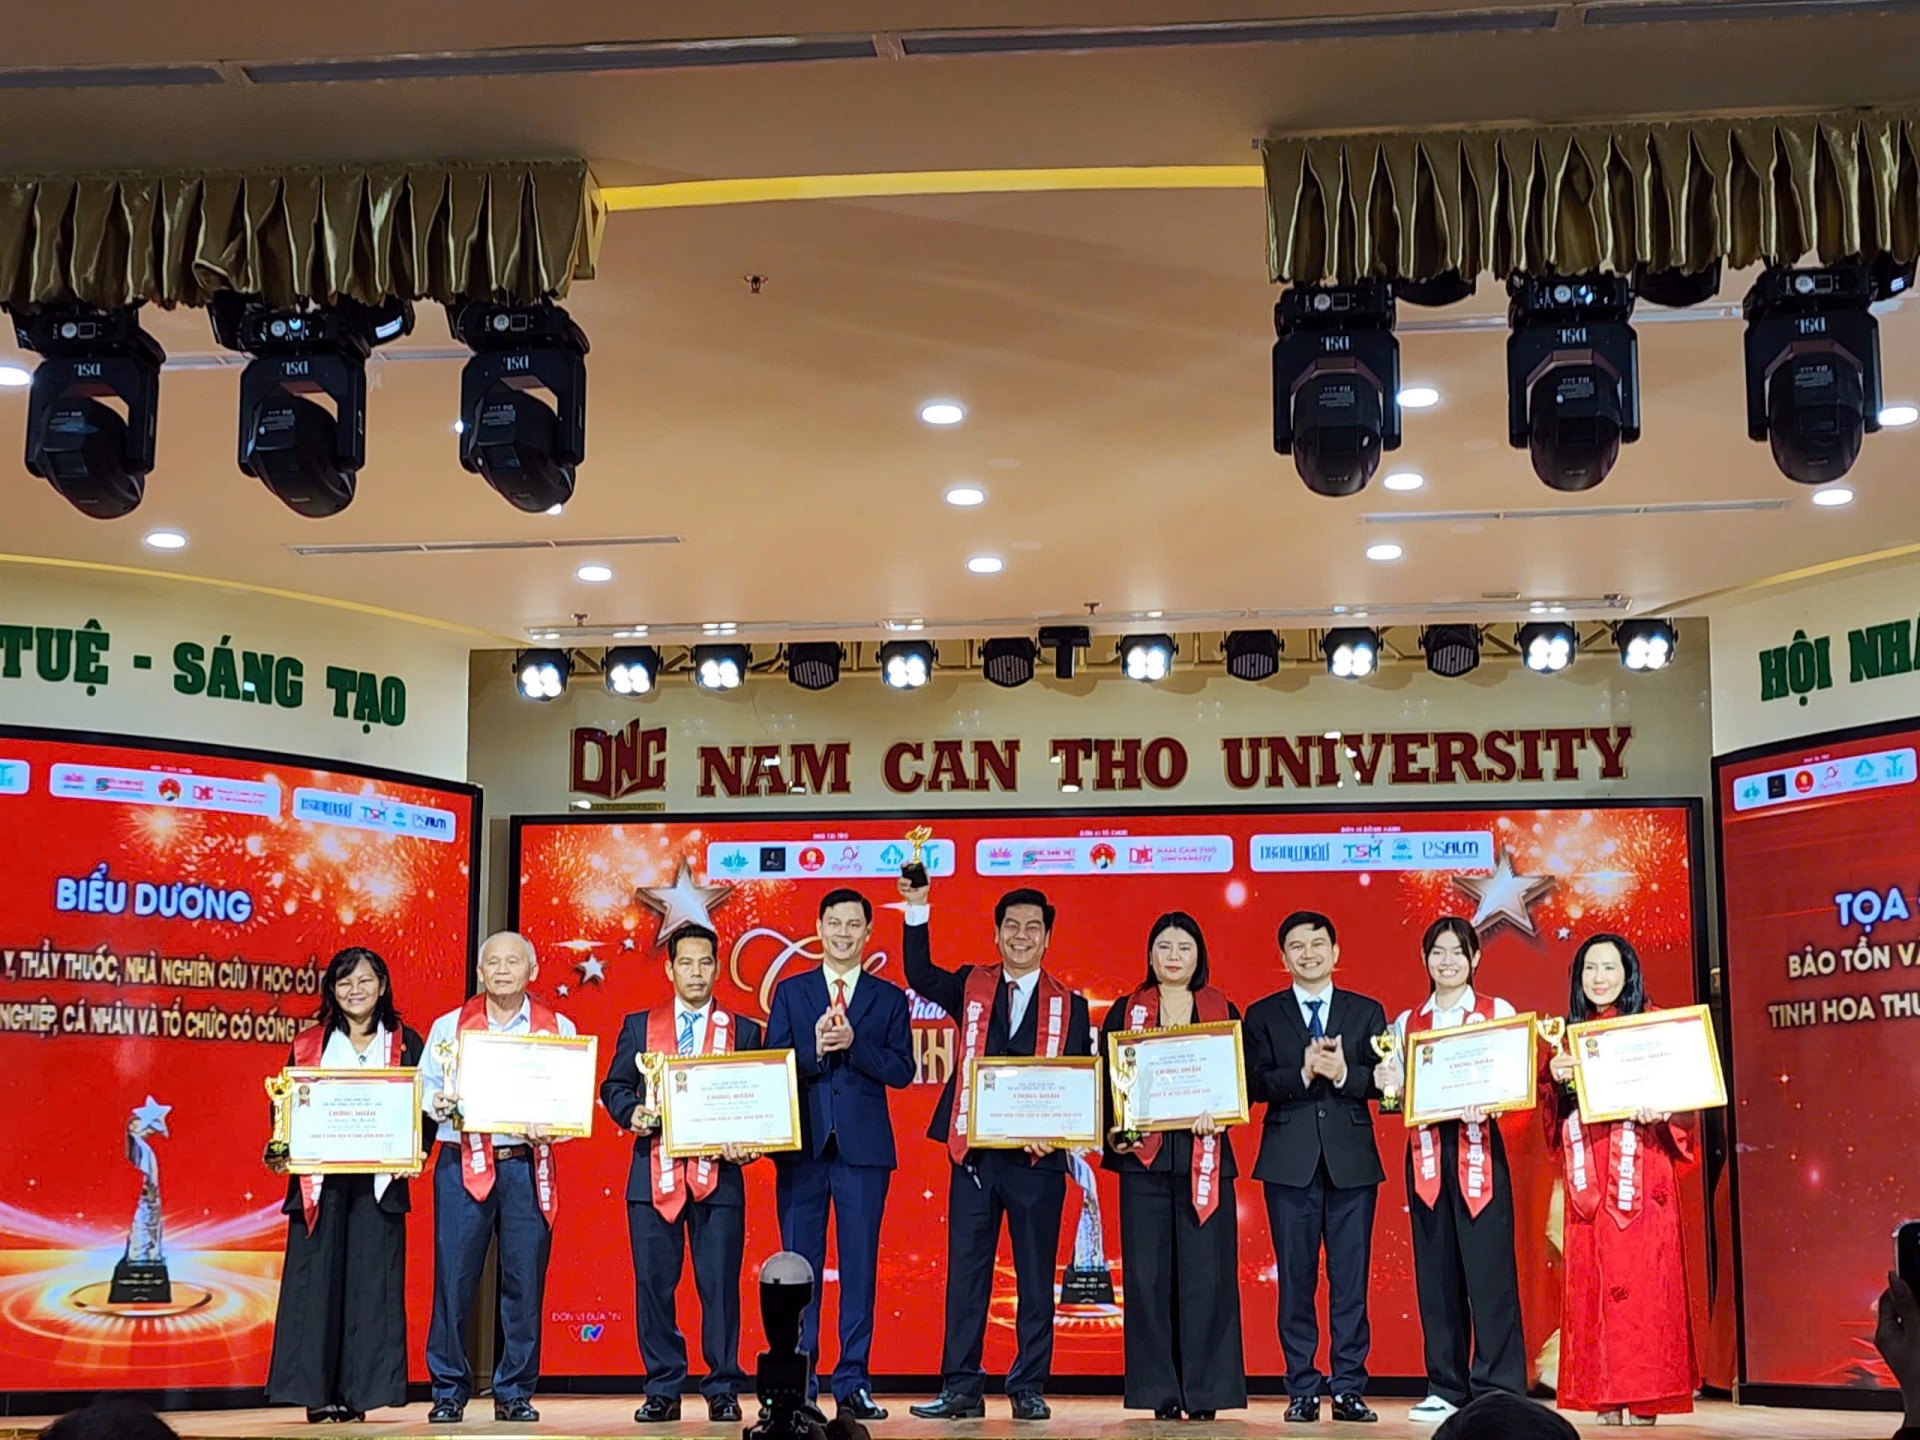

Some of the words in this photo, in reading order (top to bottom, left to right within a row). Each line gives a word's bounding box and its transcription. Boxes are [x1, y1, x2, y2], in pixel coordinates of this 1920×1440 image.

[0, 619, 110, 697] TUỆ
[173, 635, 303, 709] SÁNG
[326, 665, 407, 734] TẠO
[1759, 629, 1833, 707] HỘI
[1848, 611, 1920, 684] NH
[569, 717, 668, 800] DNC
[696, 742, 852, 798] NAM
[881, 738, 1020, 795] CAN
[1048, 735, 1190, 792] THO
[1220, 725, 1634, 789] UNIVERSITY
[56, 864, 126, 914] BIỂU
[134, 882, 252, 923] DƯƠNG
[1835, 887, 1909, 933] TỌA
[250, 965, 260, 991] Y
[262, 966, 293, 999] HỌC
[1788, 945, 1836, 978] BẢO
[1842, 936, 1890, 972] TỒN
[1768, 1001, 1816, 1028] TINH
[1822, 996, 1876, 1024] HOA
